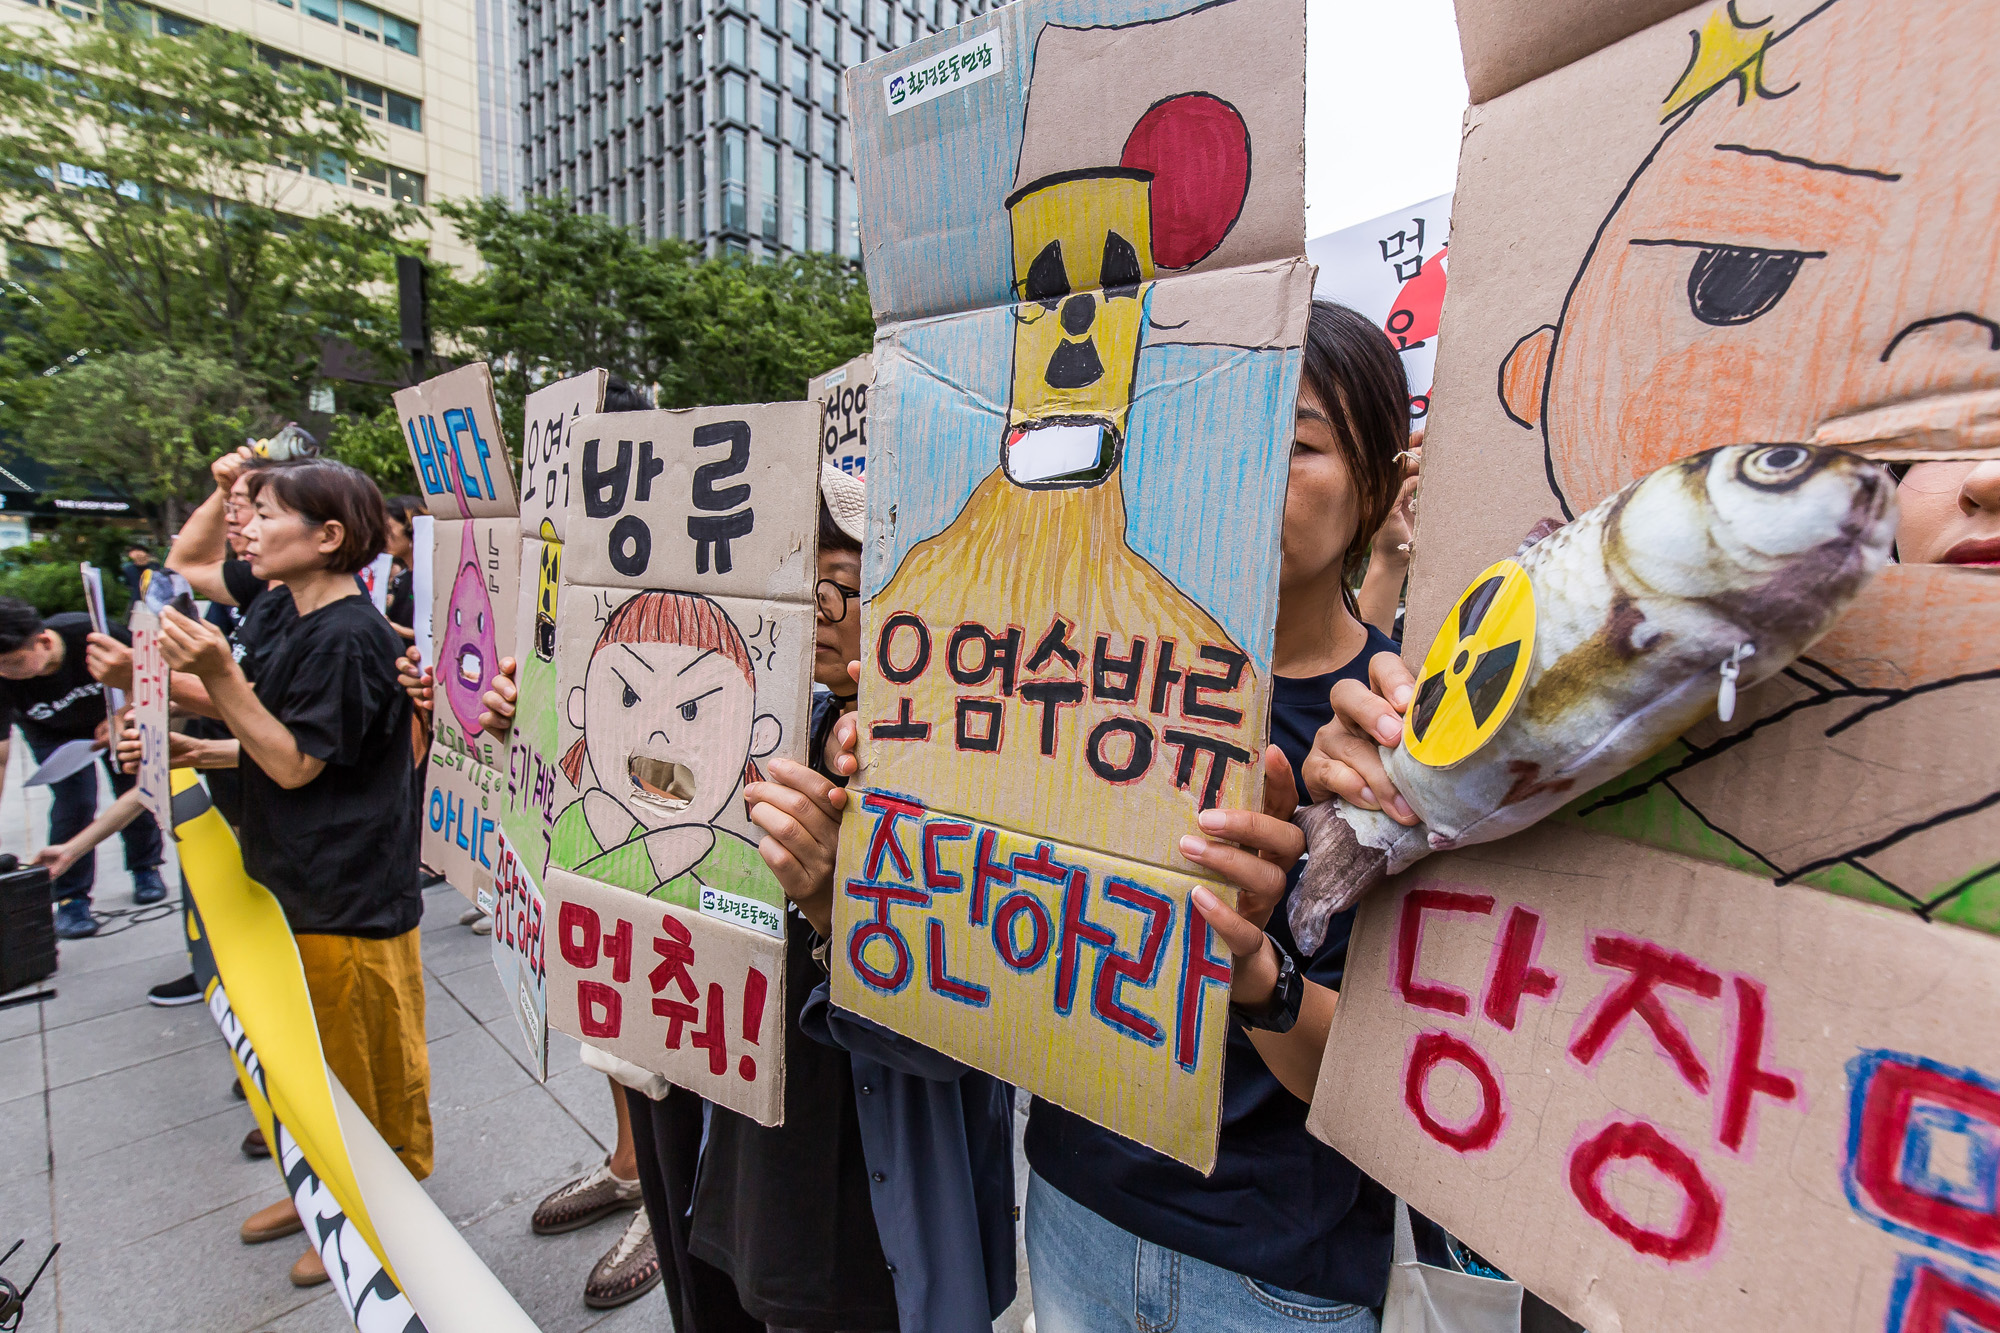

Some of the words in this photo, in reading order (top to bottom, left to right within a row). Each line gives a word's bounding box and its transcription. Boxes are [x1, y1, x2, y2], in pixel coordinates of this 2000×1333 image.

[907, 42, 992, 95] 환경운동연합
[1378, 217, 1449, 284] 멈
[408, 406, 496, 500] 바다
[582, 420, 754, 577] 방류
[868, 610, 1259, 814] 오염수방류
[717, 894, 780, 931] 환경운동연합
[844, 787, 1231, 1072] 중단하라
[558, 900, 768, 1083] 멈춰!
[1394, 888, 1801, 1263] 당장
